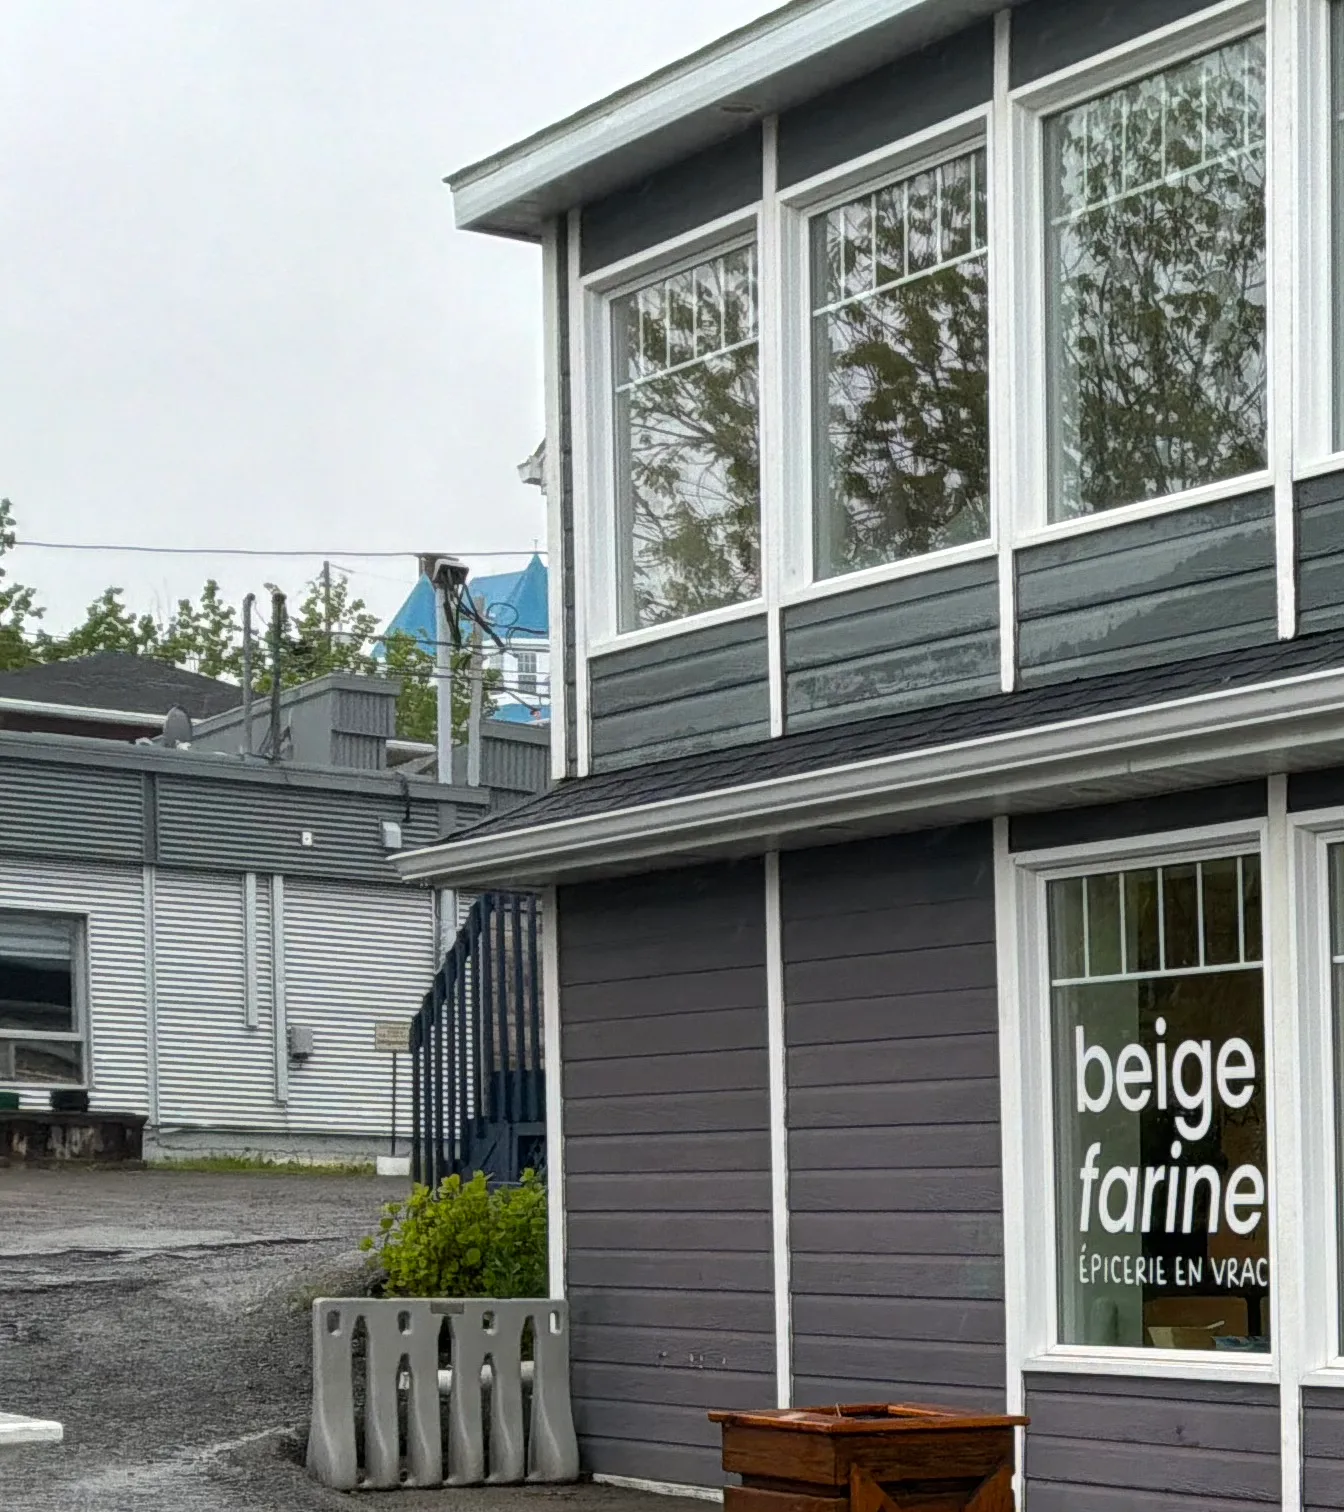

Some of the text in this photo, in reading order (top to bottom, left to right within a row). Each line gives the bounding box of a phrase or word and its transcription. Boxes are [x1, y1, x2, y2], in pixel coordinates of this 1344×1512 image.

[1075, 1016, 1256, 1141] beige
[1079, 1140, 1265, 1235] farine
[1079, 1243, 1268, 1288] ÉPICERIE EN VRAC
